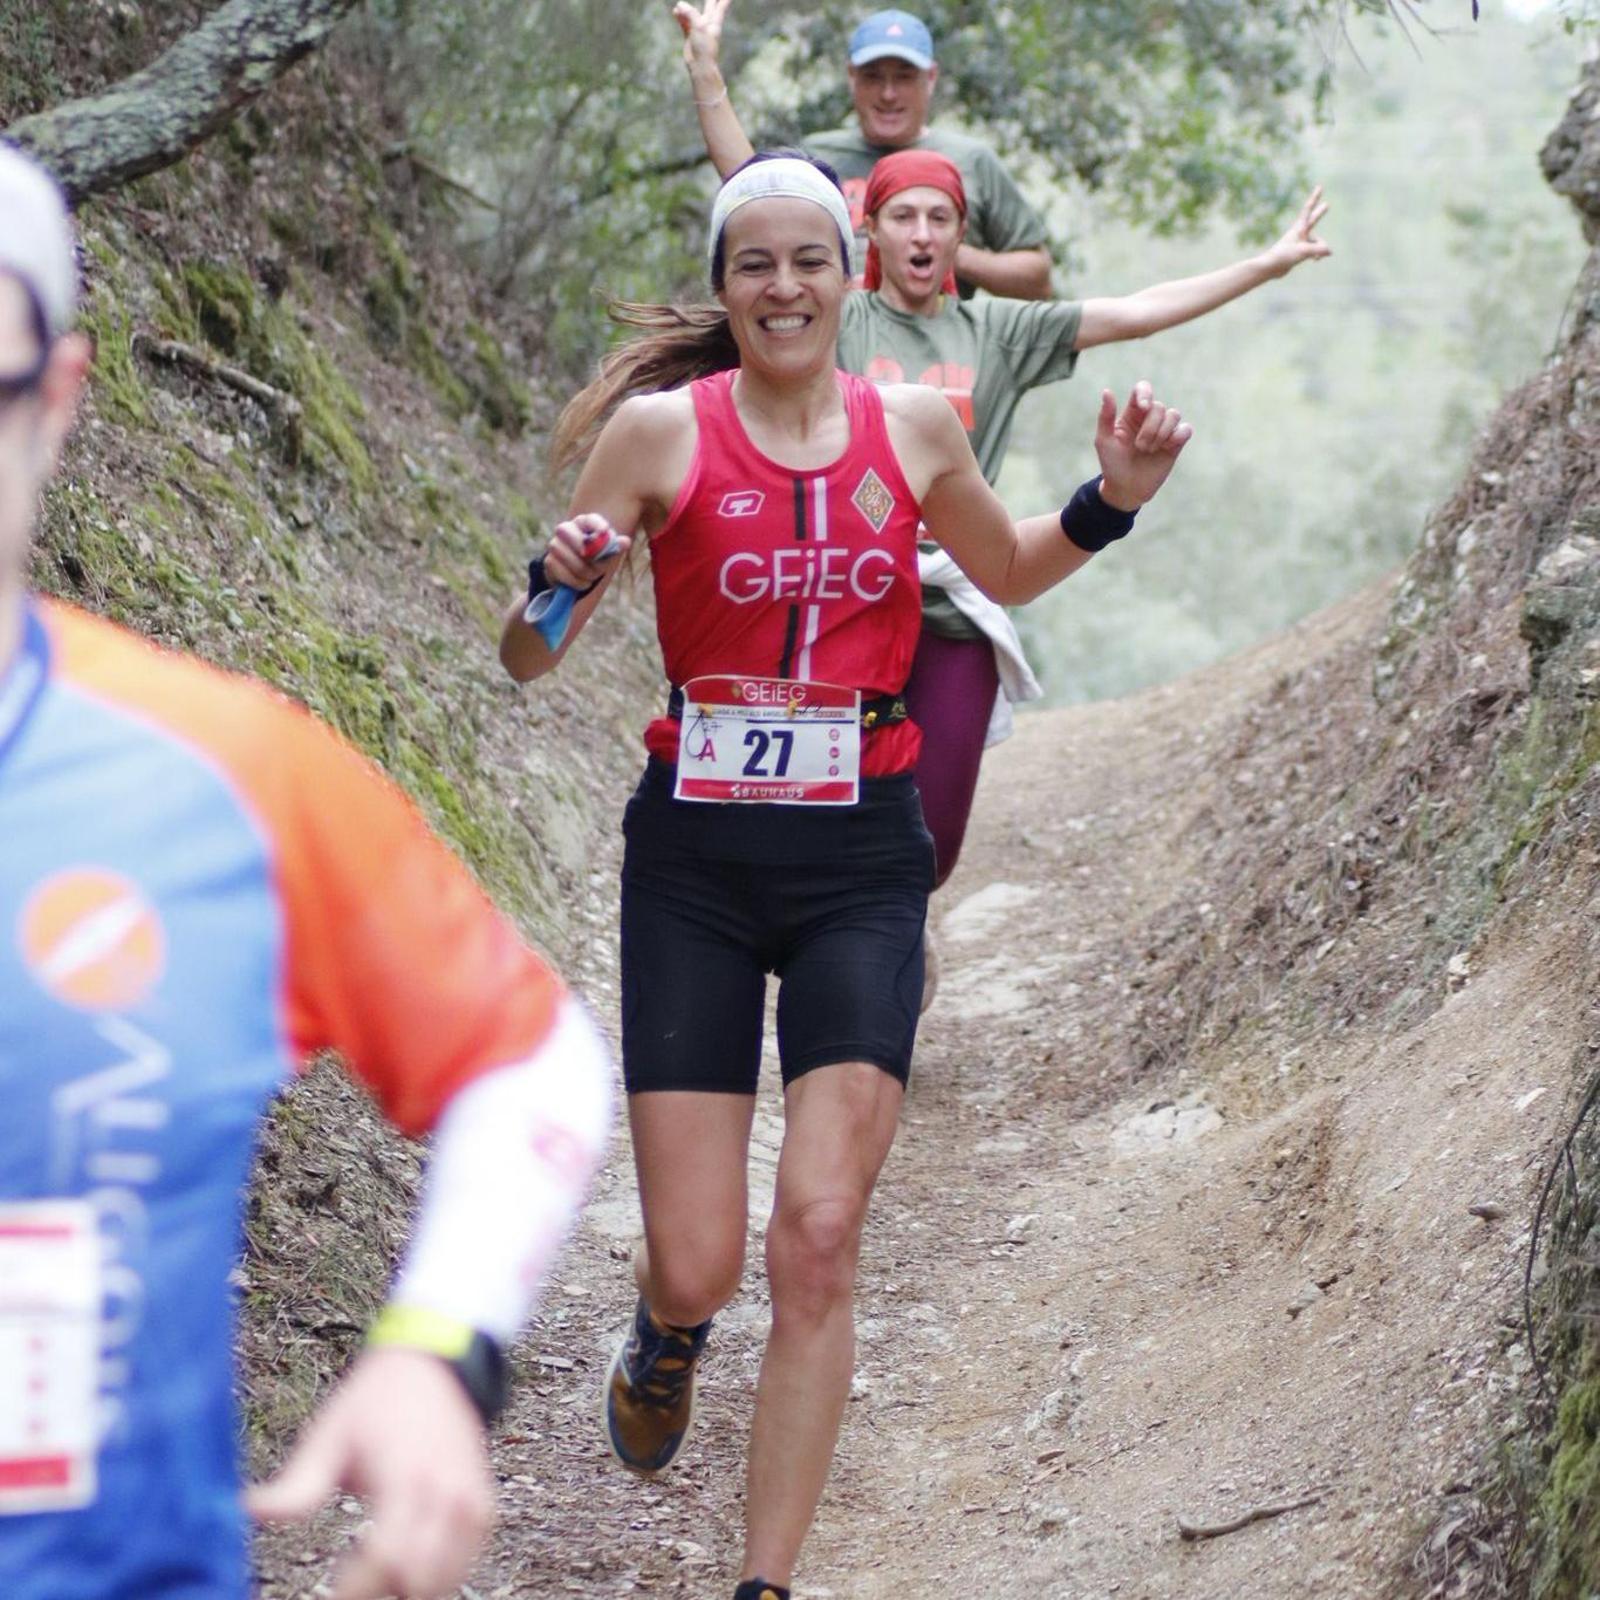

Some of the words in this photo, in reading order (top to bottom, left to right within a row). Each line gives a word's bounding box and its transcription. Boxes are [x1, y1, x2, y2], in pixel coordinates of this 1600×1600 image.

[719, 549, 896, 604] GEiEG
[742, 681, 806, 703] GEiEG
[699, 737, 717, 762] A
[742, 729, 794, 777] 27
[741, 785, 804, 799] BAUHAUS
